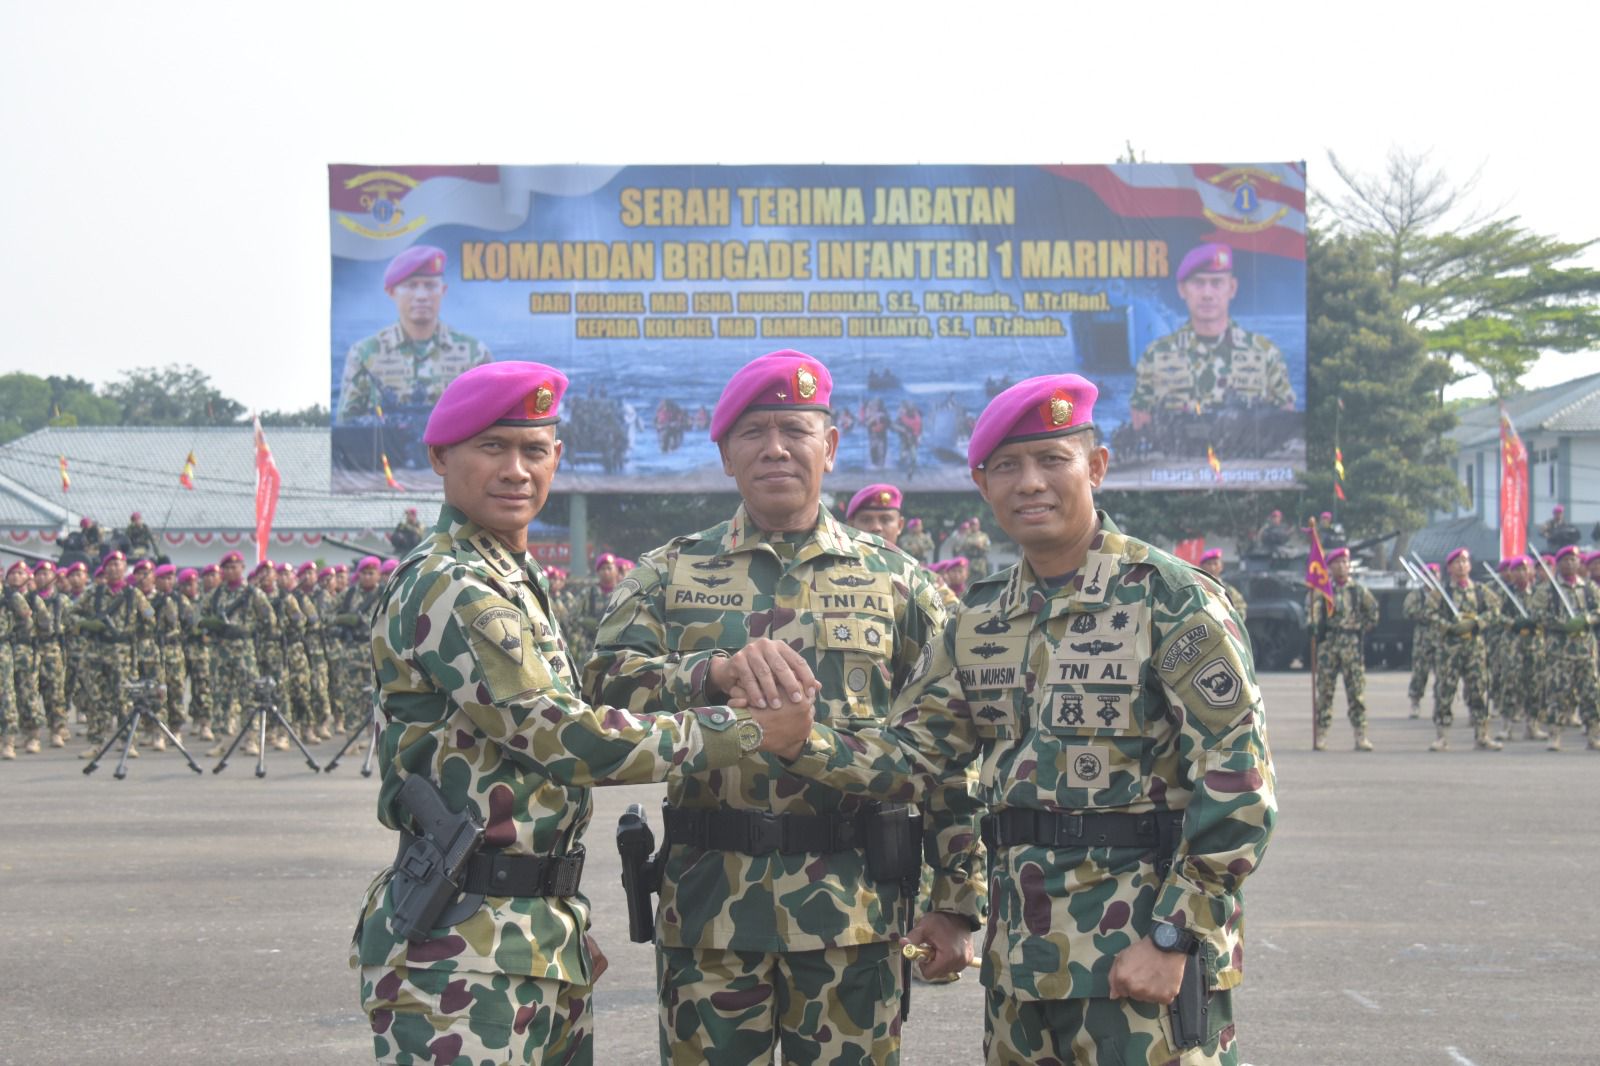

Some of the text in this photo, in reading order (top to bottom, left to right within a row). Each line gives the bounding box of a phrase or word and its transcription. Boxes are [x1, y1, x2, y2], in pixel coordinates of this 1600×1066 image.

[620, 187, 1017, 227] SERAH TERIMA JABATAN
[461, 240, 1169, 280] KOMANDAN BRIGADE INFANTERI 1 MARINIR
[530, 294, 571, 313] DARI
[576, 293, 646, 313] KOLONEL
[651, 293, 688, 313] MAR
[738, 292, 804, 313] MUHSIN
[809, 292, 882, 313] ABDILAH,
[888, 292, 918, 313] S.E.,
[576, 319, 640, 339] KEPADA
[644, 319, 714, 338] KOLONEL
[718, 318, 756, 338] MAR
[761, 318, 841, 337] BAMBANG
[848, 317, 932, 338] DILLIANTO,
[938, 317, 970, 338] S.E.,
[1263, 467, 1294, 482] 2024
[674, 589, 744, 607] FAROUQ
[819, 594, 889, 612] TNI AL
[1183, 647, 1197, 661] M
[980, 667, 1016, 686] MUHSIN
[1059, 663, 1128, 680] TNI AL
